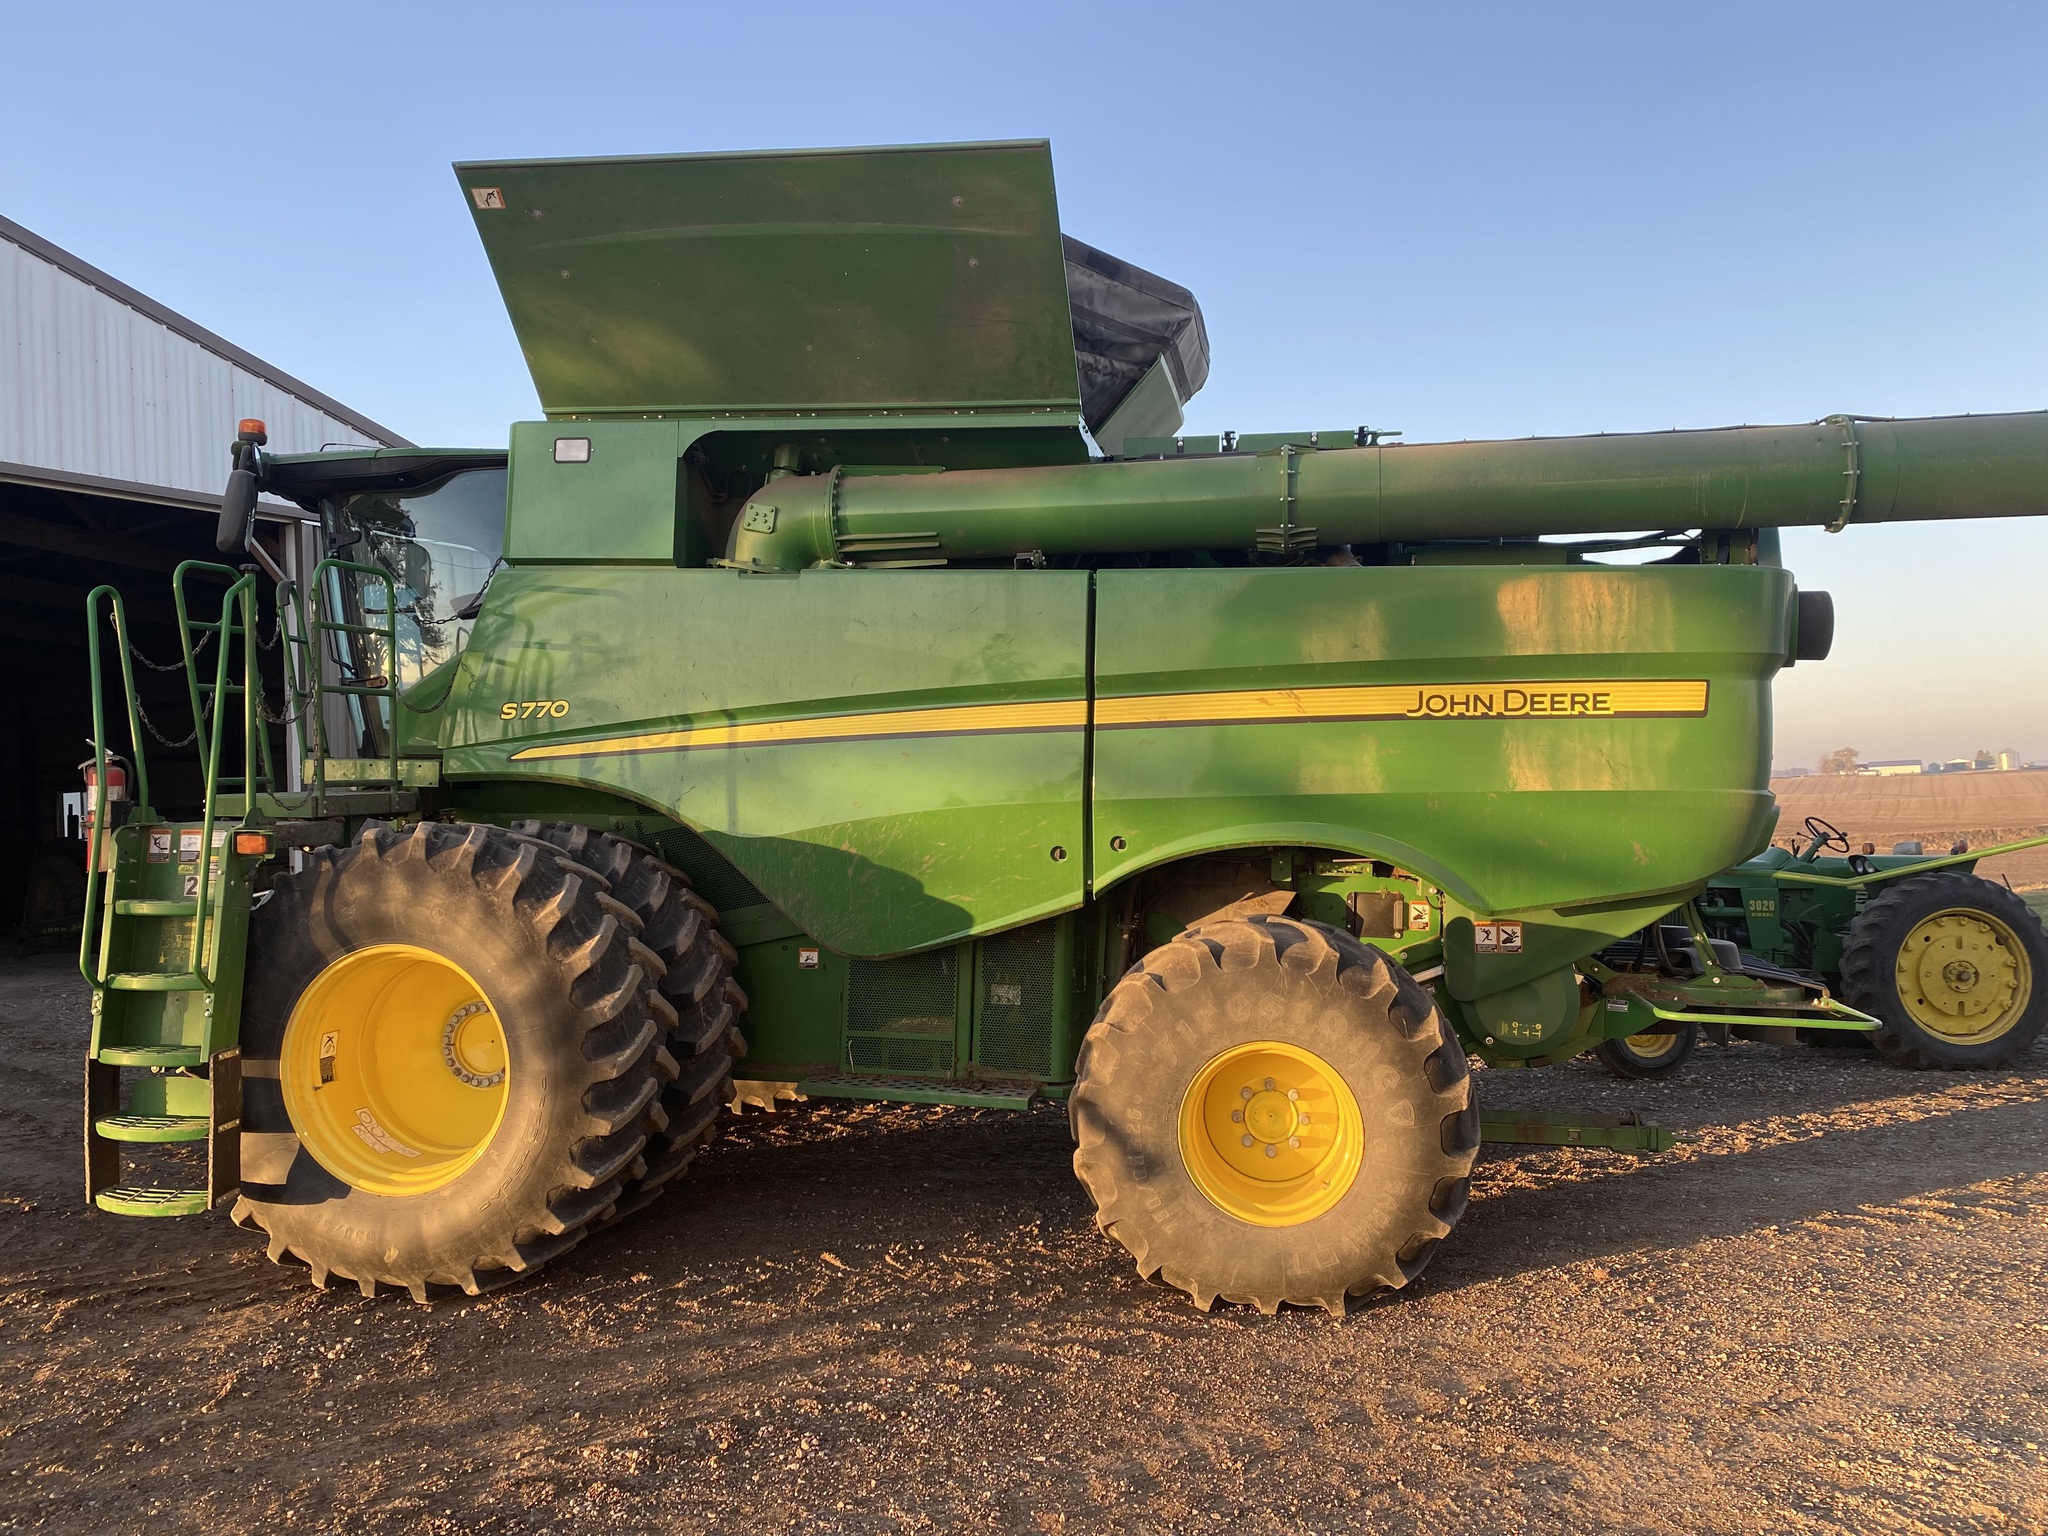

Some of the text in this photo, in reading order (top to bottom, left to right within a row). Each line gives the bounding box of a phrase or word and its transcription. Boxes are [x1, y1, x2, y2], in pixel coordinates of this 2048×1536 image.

[500, 699, 570, 720] S770
[1406, 689, 1612, 714] JOHN DEERE
[186, 876, 198, 896] 2
[1749, 900, 1775, 911] 3020
[1152, 992, 1402, 1091] Firestone
